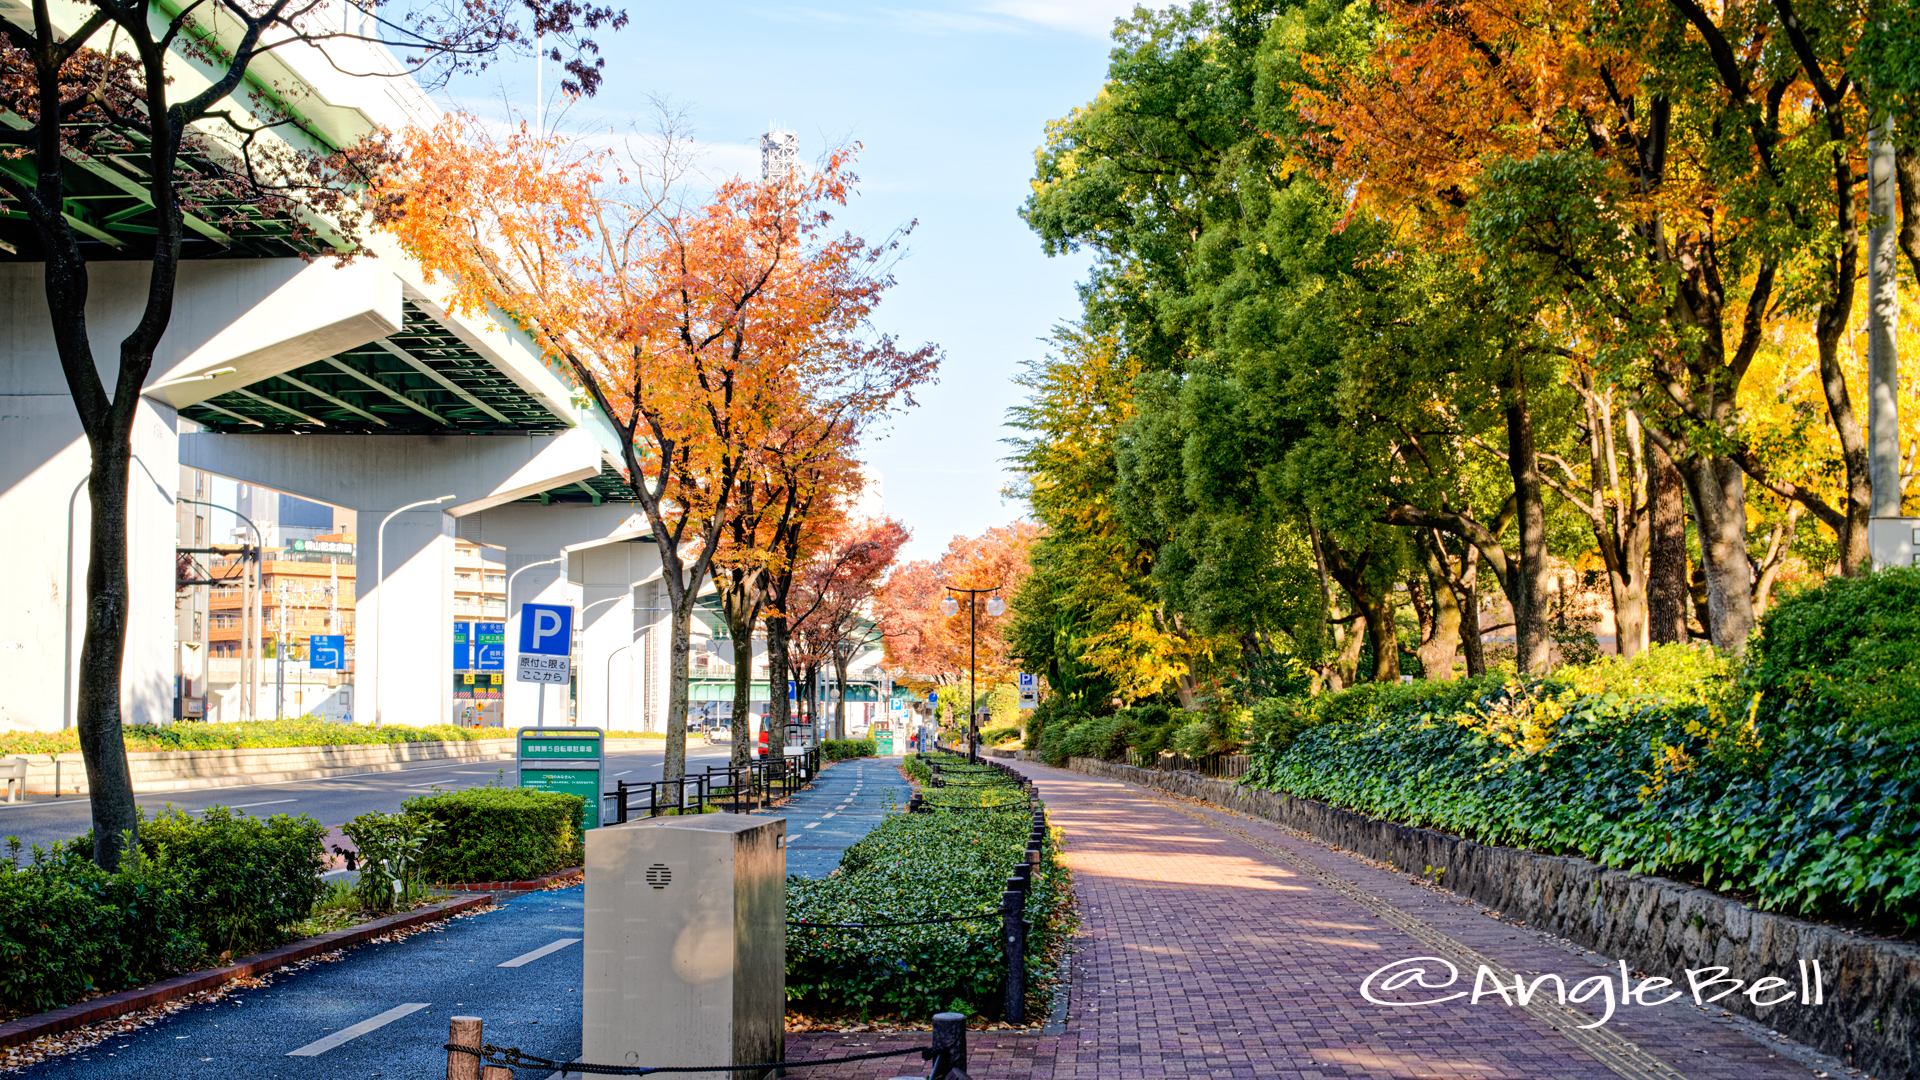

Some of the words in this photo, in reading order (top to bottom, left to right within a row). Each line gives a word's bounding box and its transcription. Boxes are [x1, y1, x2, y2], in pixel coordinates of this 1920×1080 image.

[533, 609, 562, 649] P
[520, 657, 566, 669] 原付に限る
[522, 670, 563, 682] ここから
[1022, 673, 1031, 685] P
[893, 700, 900, 710] P
